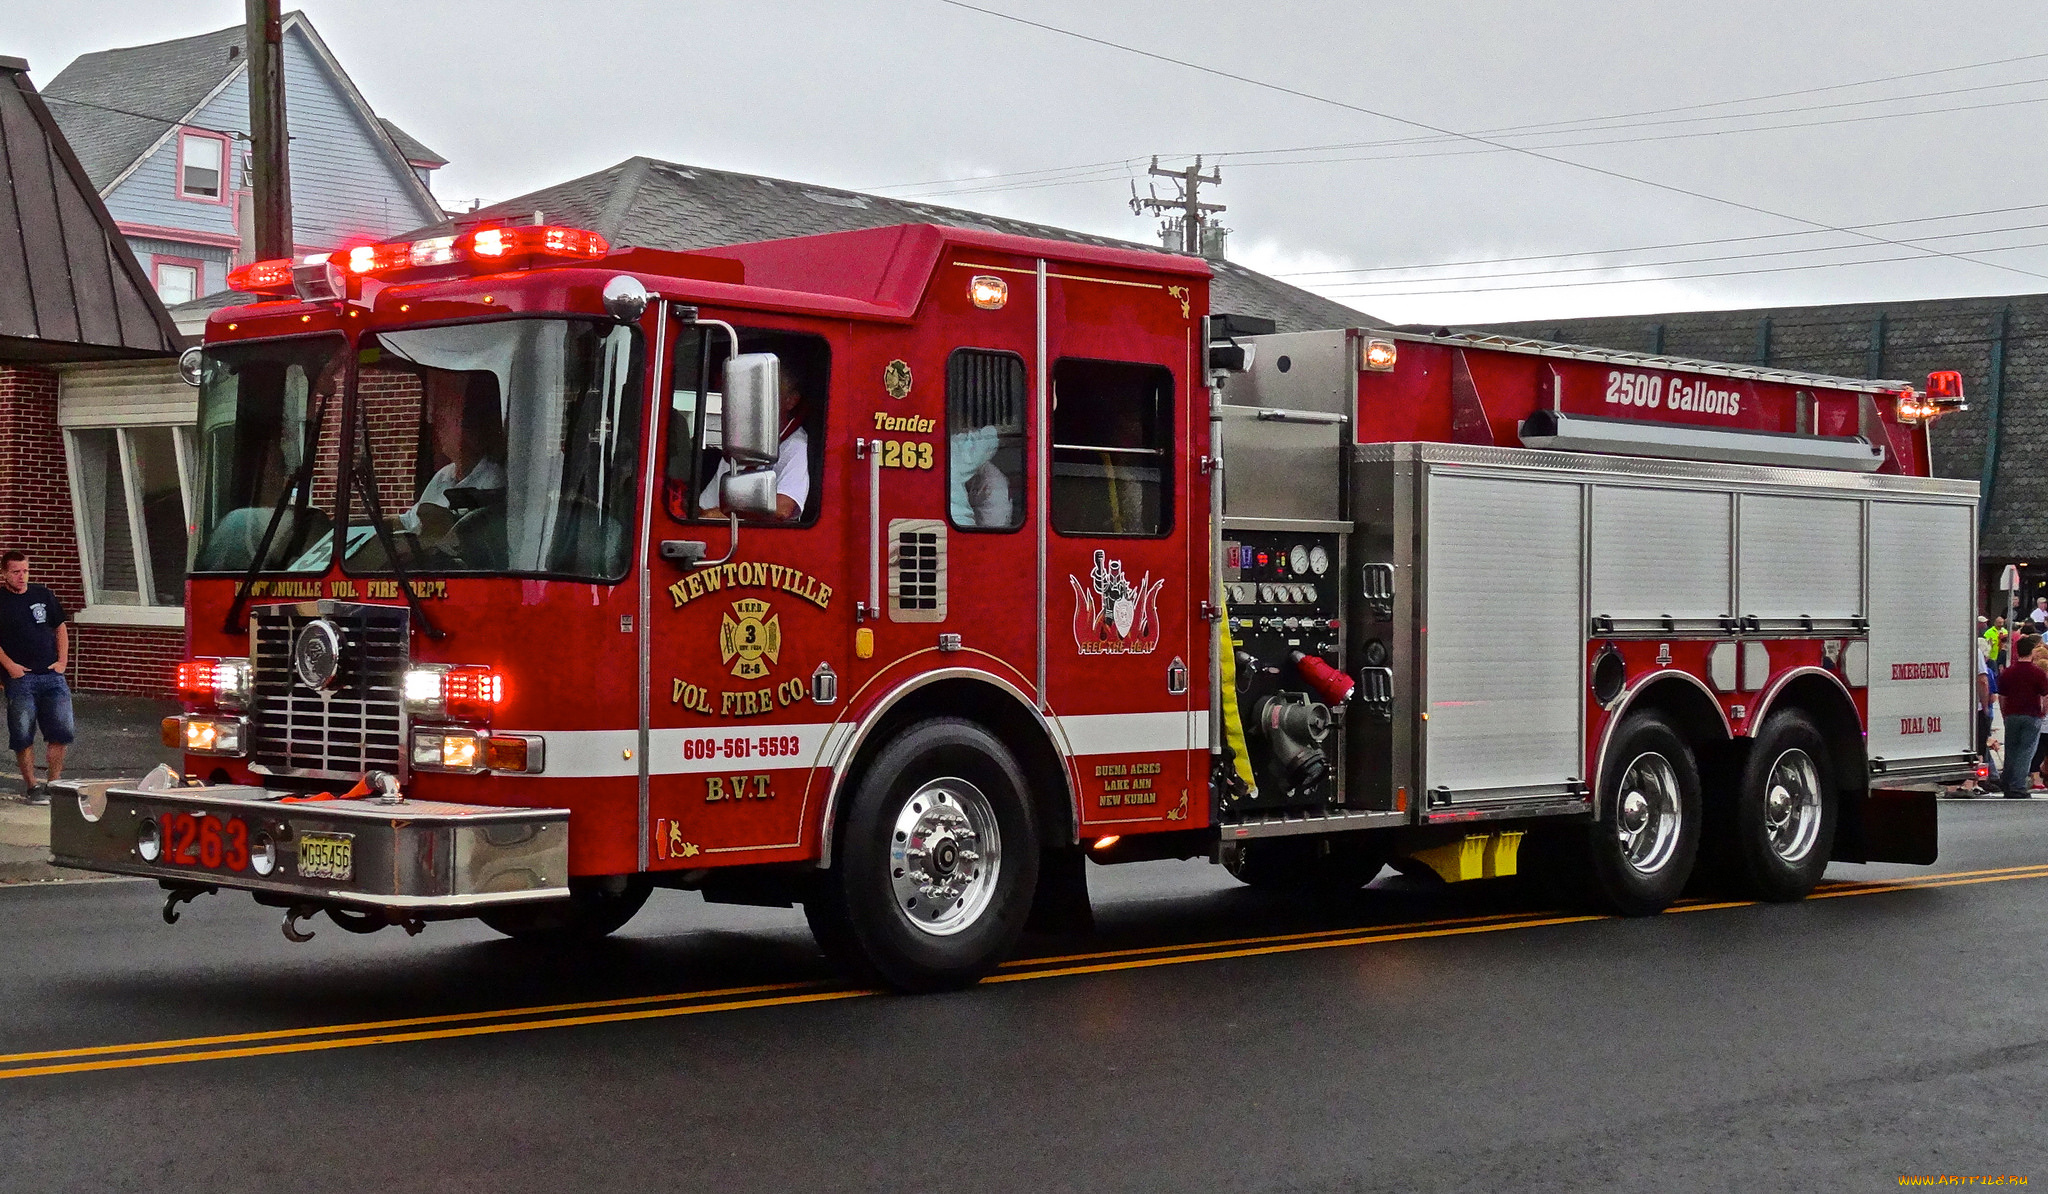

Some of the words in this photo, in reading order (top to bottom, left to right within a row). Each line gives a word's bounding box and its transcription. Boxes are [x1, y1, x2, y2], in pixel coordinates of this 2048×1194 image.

[1605, 371, 1662, 408] 2500
[1667, 378, 1740, 416] Gallons
[874, 412, 936, 433] Tender
[330, 581, 359, 598] VOL.
[367, 580, 398, 598] FIRE
[669, 561, 833, 609] NEWTONVILLE
[745, 624, 756, 644] 3
[1892, 662, 1950, 680] EMERGENCY
[672, 678, 714, 714] VOL.
[721, 688, 773, 715] FIRE
[778, 677, 809, 706] CO.
[1901, 717, 1924, 735] DIAL
[1927, 716, 1942, 733] 911
[683, 736, 800, 760] 609-561-5593
[1130, 763, 1161, 775] ACRES
[706, 775, 776, 801] B.V.T.
[1104, 779, 1130, 792] LAKE
[1100, 794, 1121, 807] NEW
[160, 812, 250, 873] 1263
[301, 843, 349, 868] MG95456
